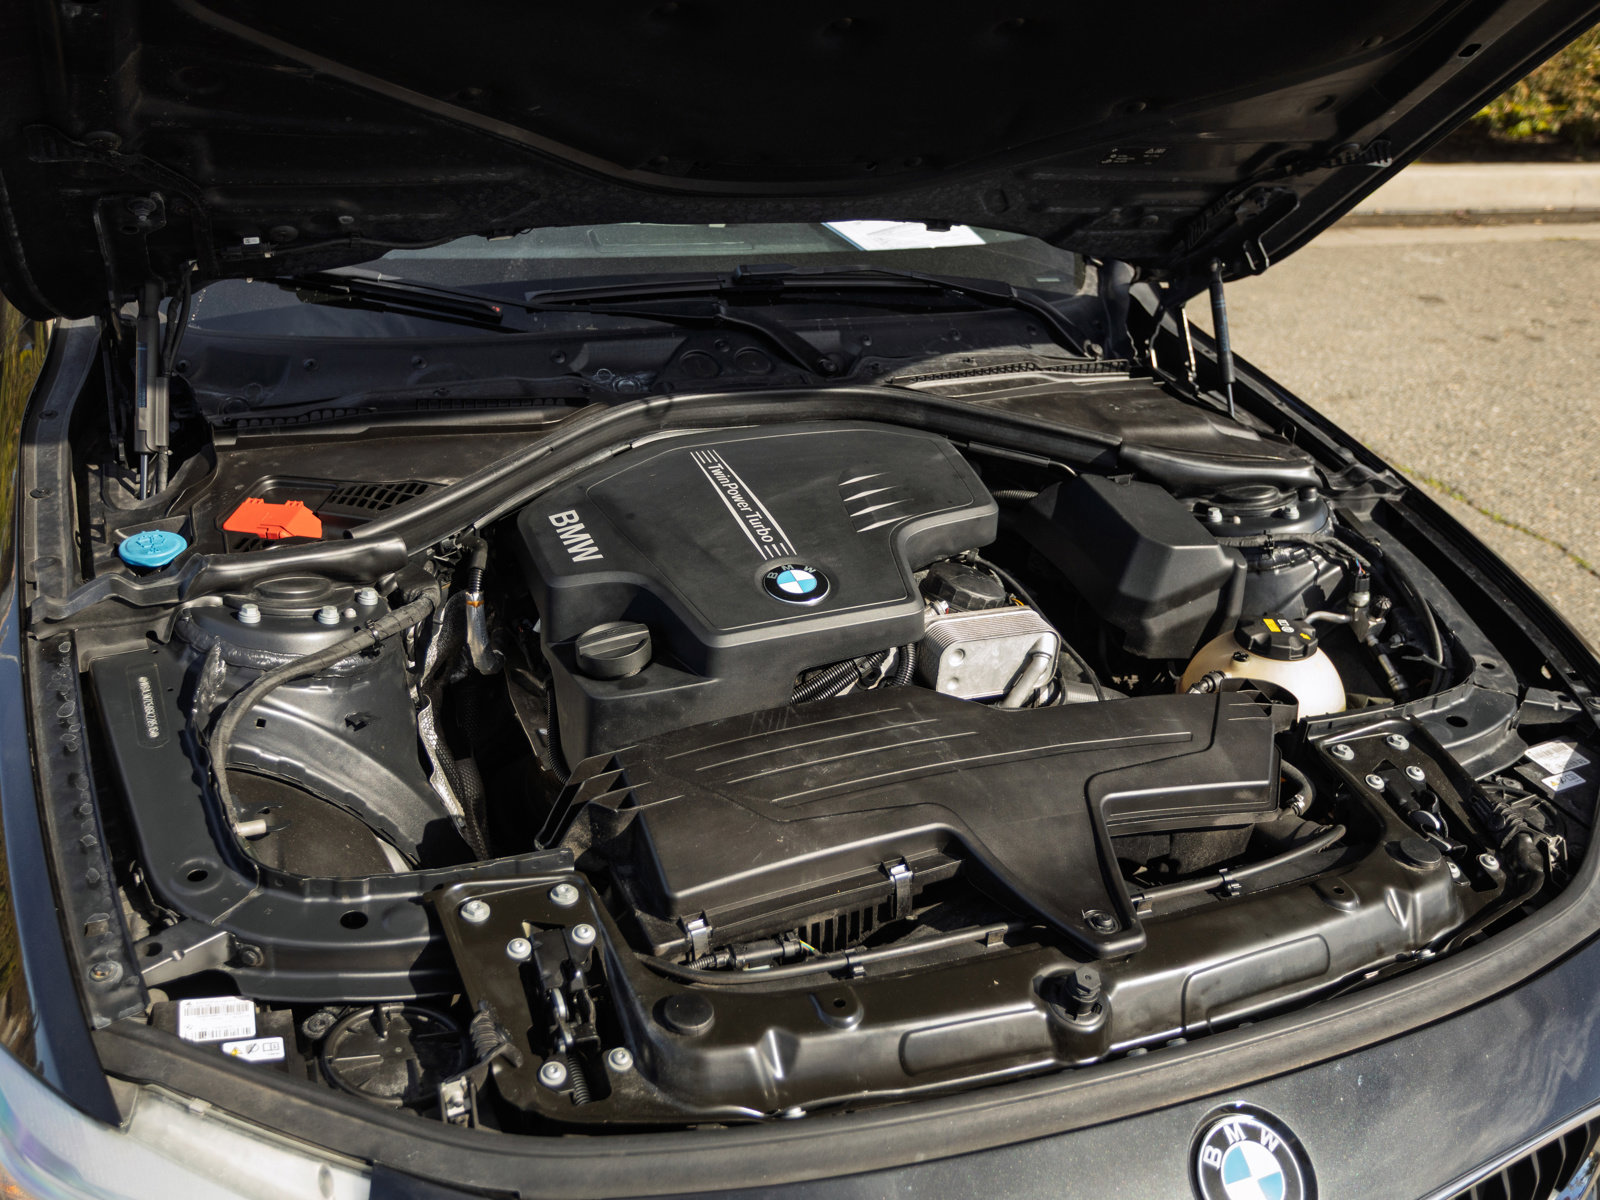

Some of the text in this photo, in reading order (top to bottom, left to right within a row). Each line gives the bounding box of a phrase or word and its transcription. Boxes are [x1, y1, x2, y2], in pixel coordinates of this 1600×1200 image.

[708, 463, 775, 544] TwinPower Turbo
[548, 509, 604, 563] BMW
[767, 564, 817, 580] BMW
[1203, 1122, 1281, 1171] BMW
